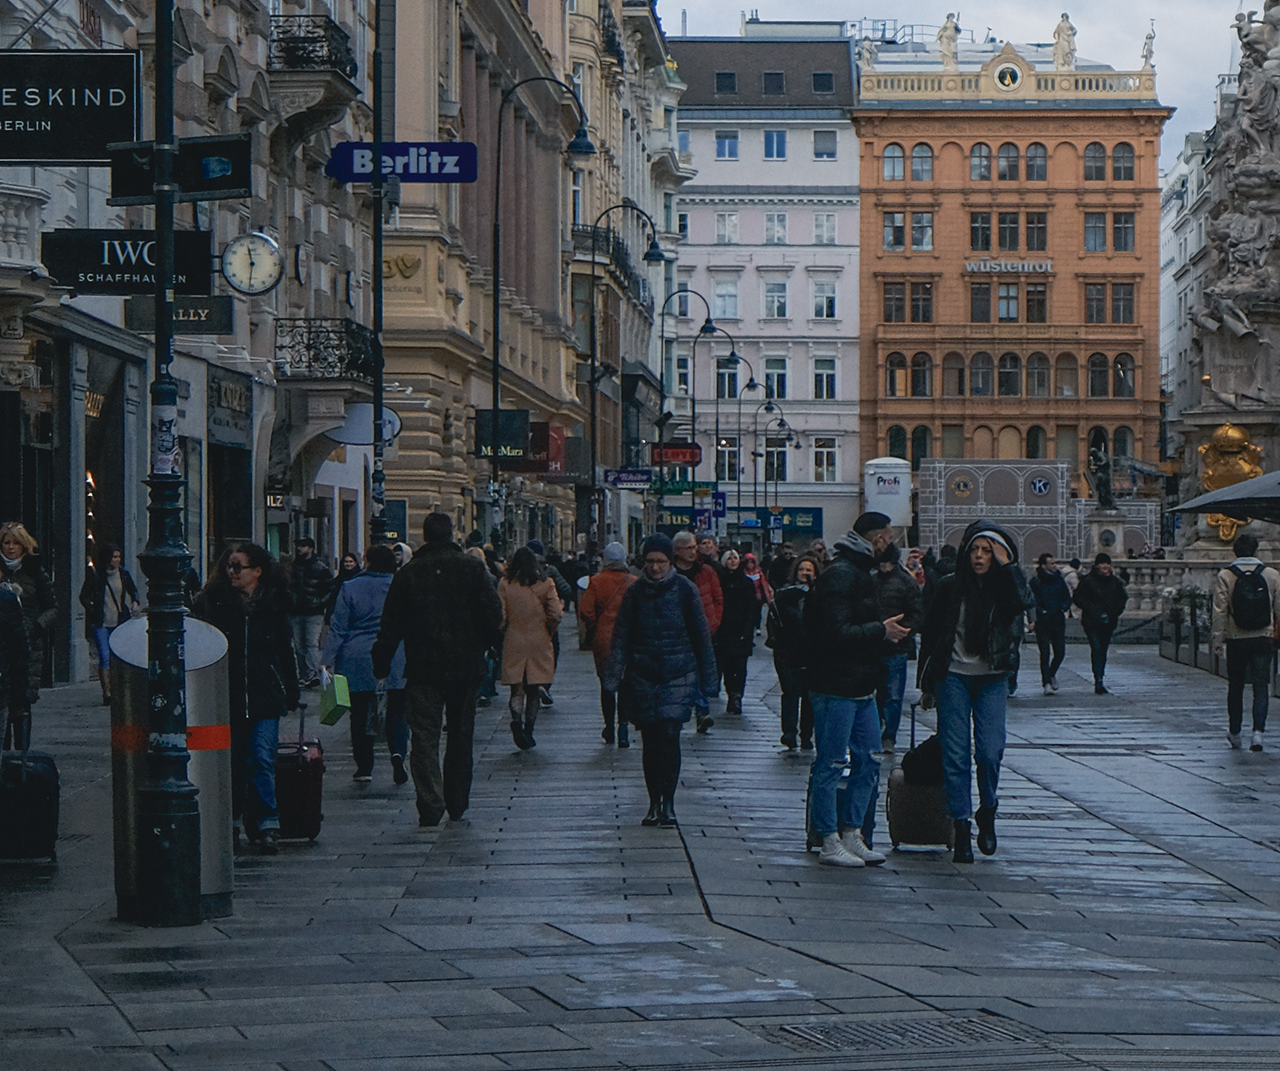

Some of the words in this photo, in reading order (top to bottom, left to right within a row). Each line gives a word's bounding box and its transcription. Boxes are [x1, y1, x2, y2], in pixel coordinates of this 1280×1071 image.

[1, 87, 127, 107] ESKIND
[352, 146, 460, 174] Berlitz
[965, 257, 1054, 273] wüstenrot
[172, 309, 210, 321] ALLY
[876, 475, 901, 487] Profi
